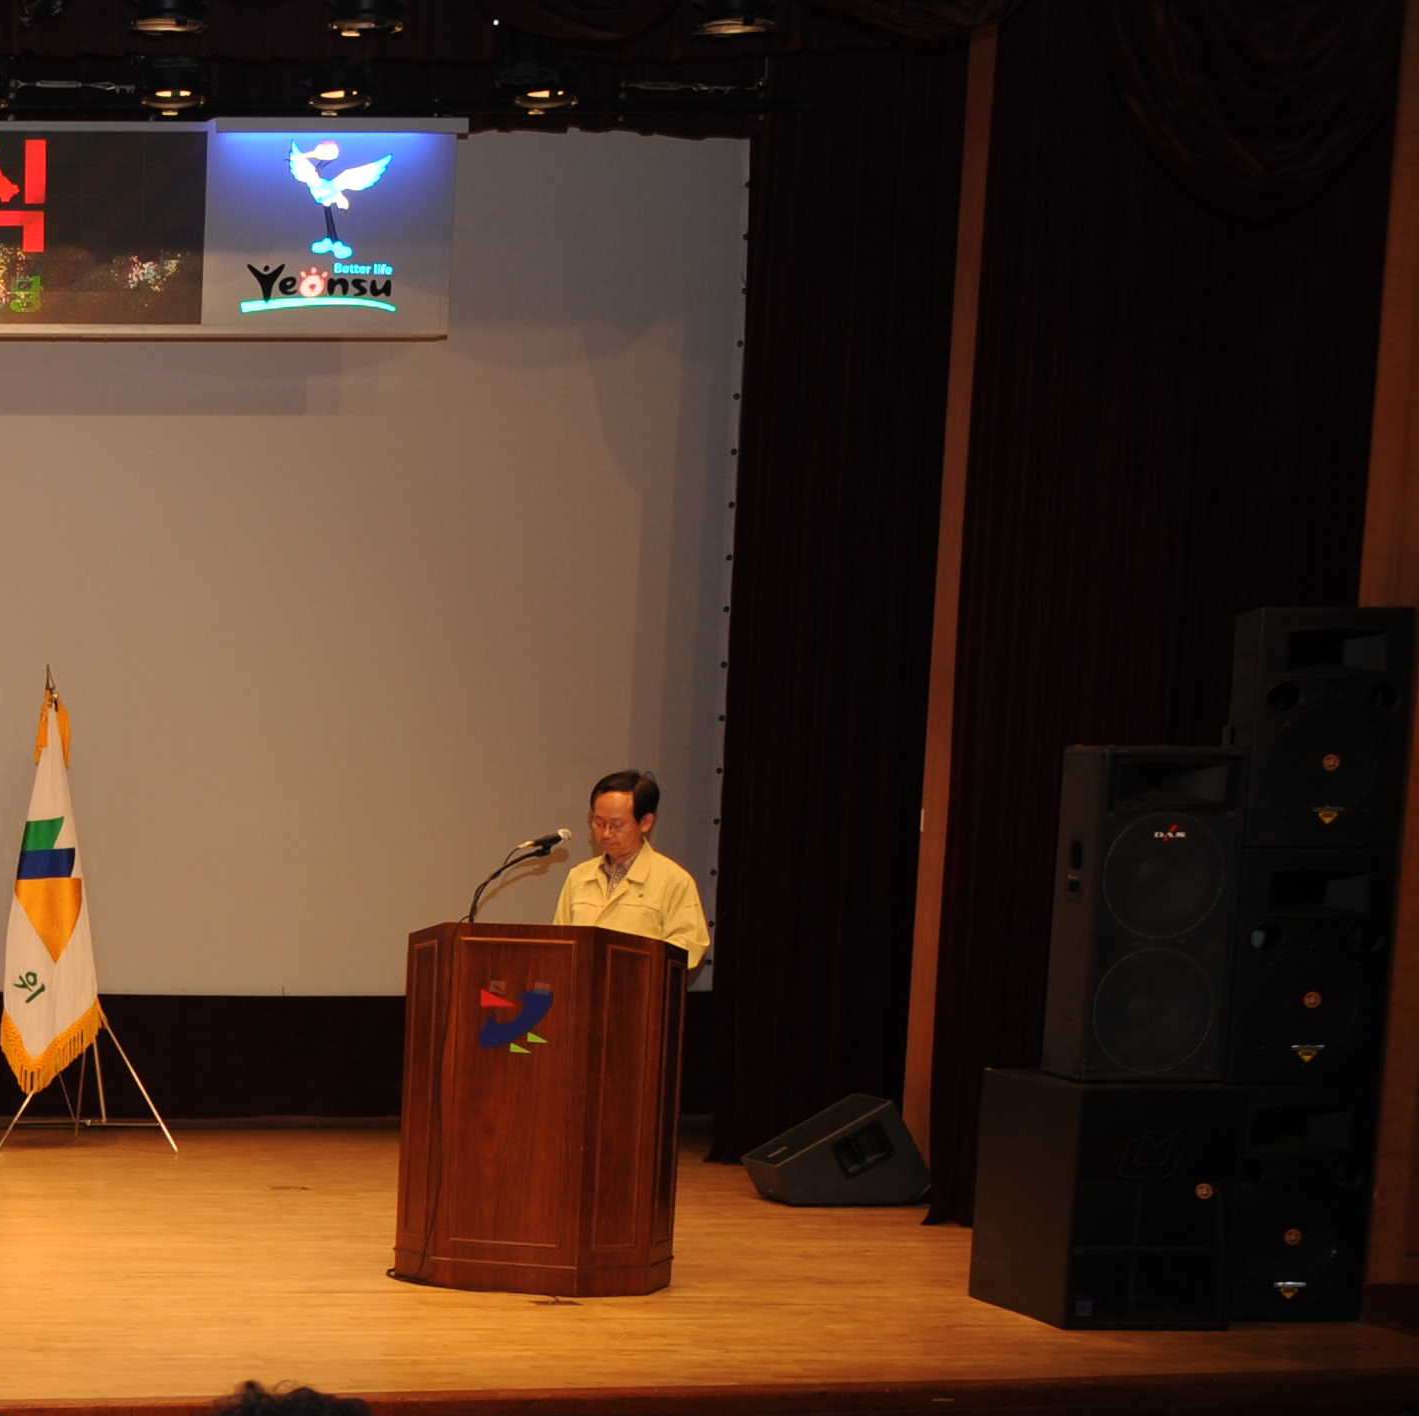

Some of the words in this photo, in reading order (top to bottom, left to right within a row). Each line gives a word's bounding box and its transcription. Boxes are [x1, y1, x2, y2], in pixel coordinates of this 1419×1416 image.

[333, 262, 371, 275] Better
[374, 262, 394, 275] life
[247, 263, 392, 303] Yeonsu
